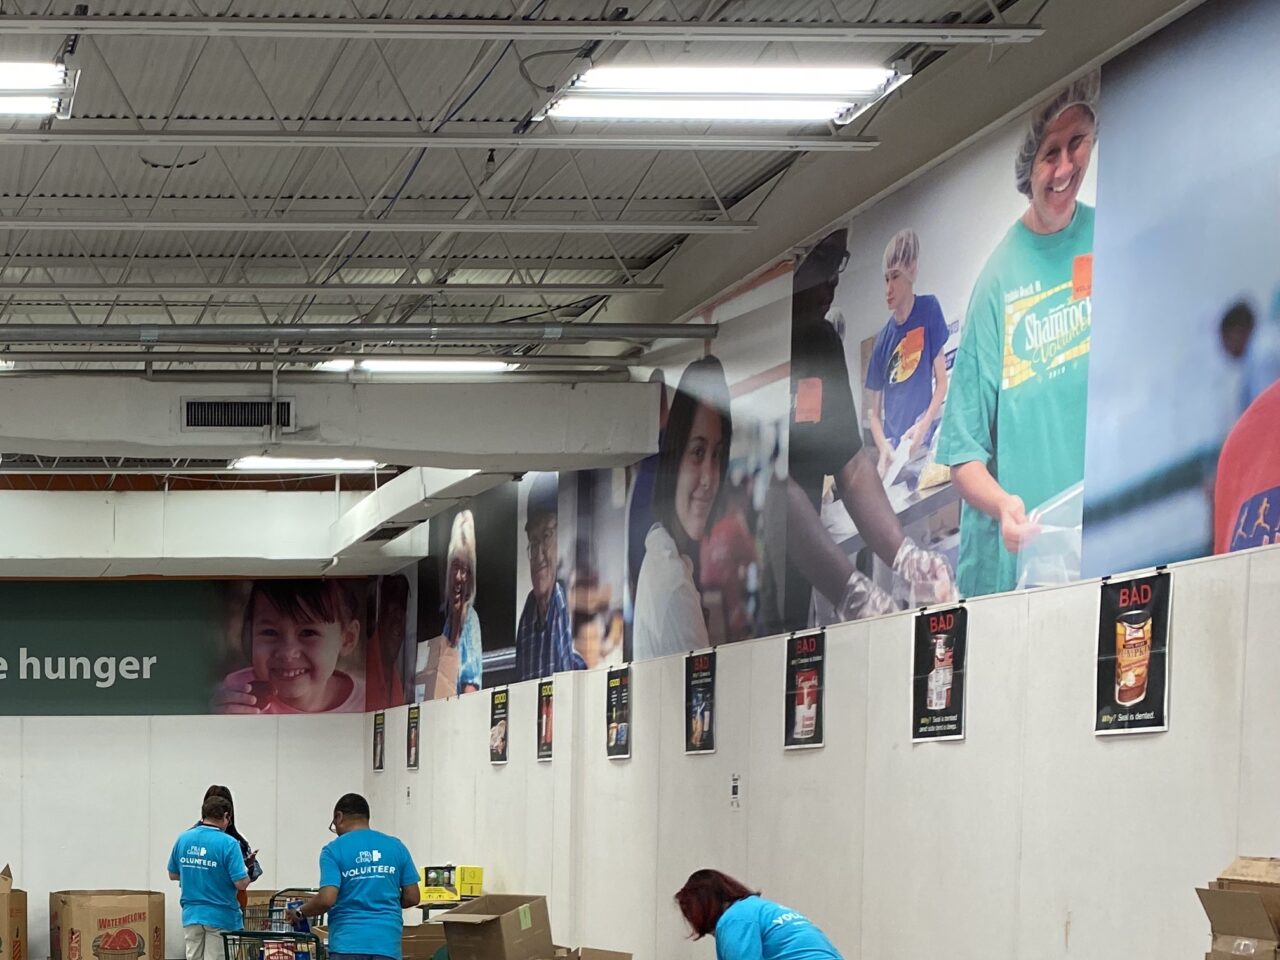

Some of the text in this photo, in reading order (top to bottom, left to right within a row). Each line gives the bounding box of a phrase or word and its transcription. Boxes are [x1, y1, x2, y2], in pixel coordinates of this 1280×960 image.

[1119, 584, 1152, 608] BAD
[929, 613, 954, 633] BAD
[796, 637, 817, 655] BAD
[18, 648, 157, 687] hunger
[180, 857, 217, 868] OLUNTEER
[342, 865, 396, 878] VOLUNTEER
[97, 912, 147, 930] WATERMELONS
